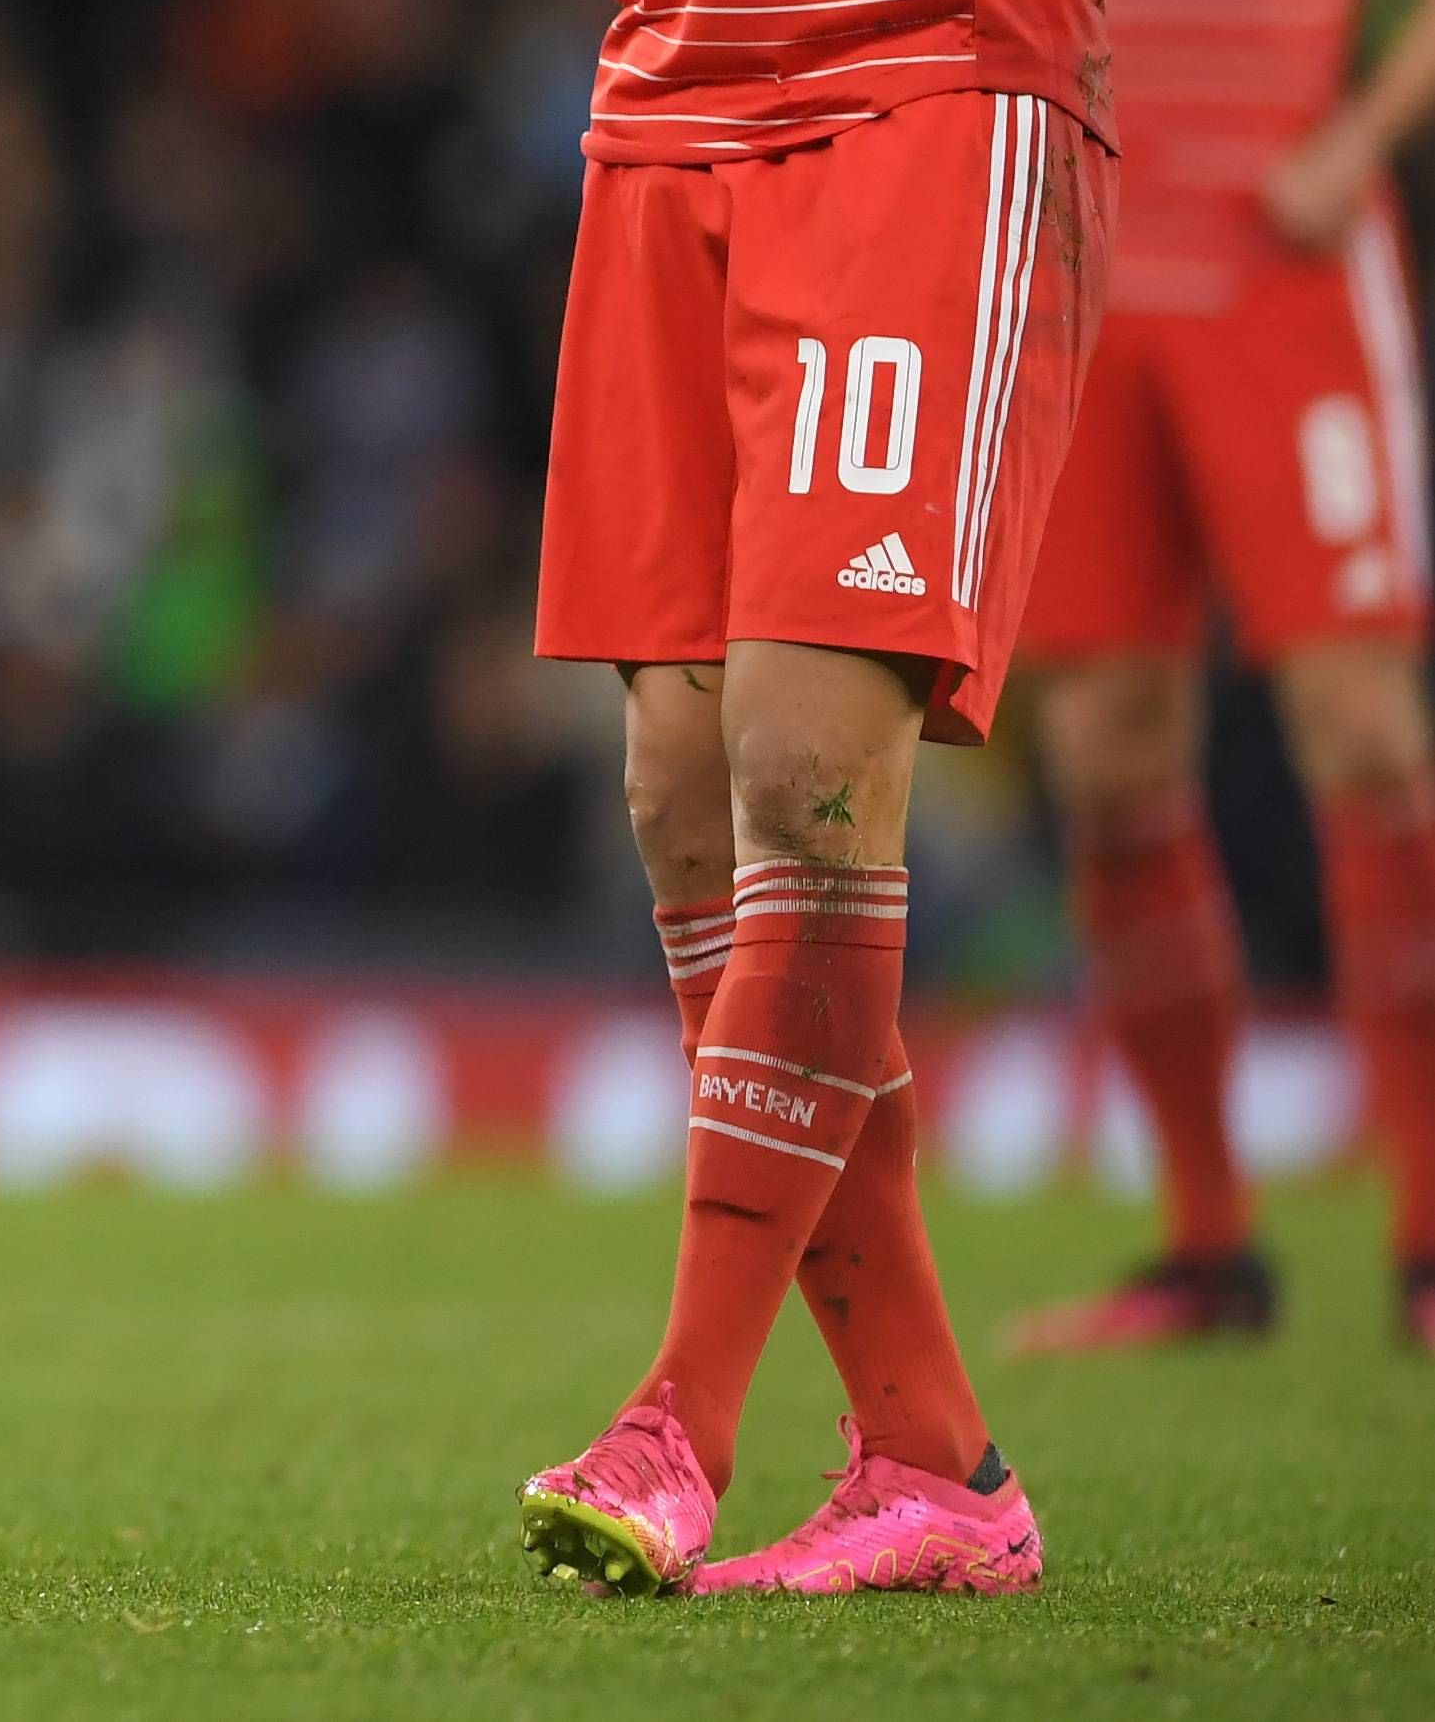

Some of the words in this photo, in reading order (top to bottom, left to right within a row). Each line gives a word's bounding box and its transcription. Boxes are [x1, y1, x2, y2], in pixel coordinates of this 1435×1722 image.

[788, 335, 923, 495] 10
[837, 566, 928, 596] adidas
[698, 1073, 817, 1128] BAYERN
